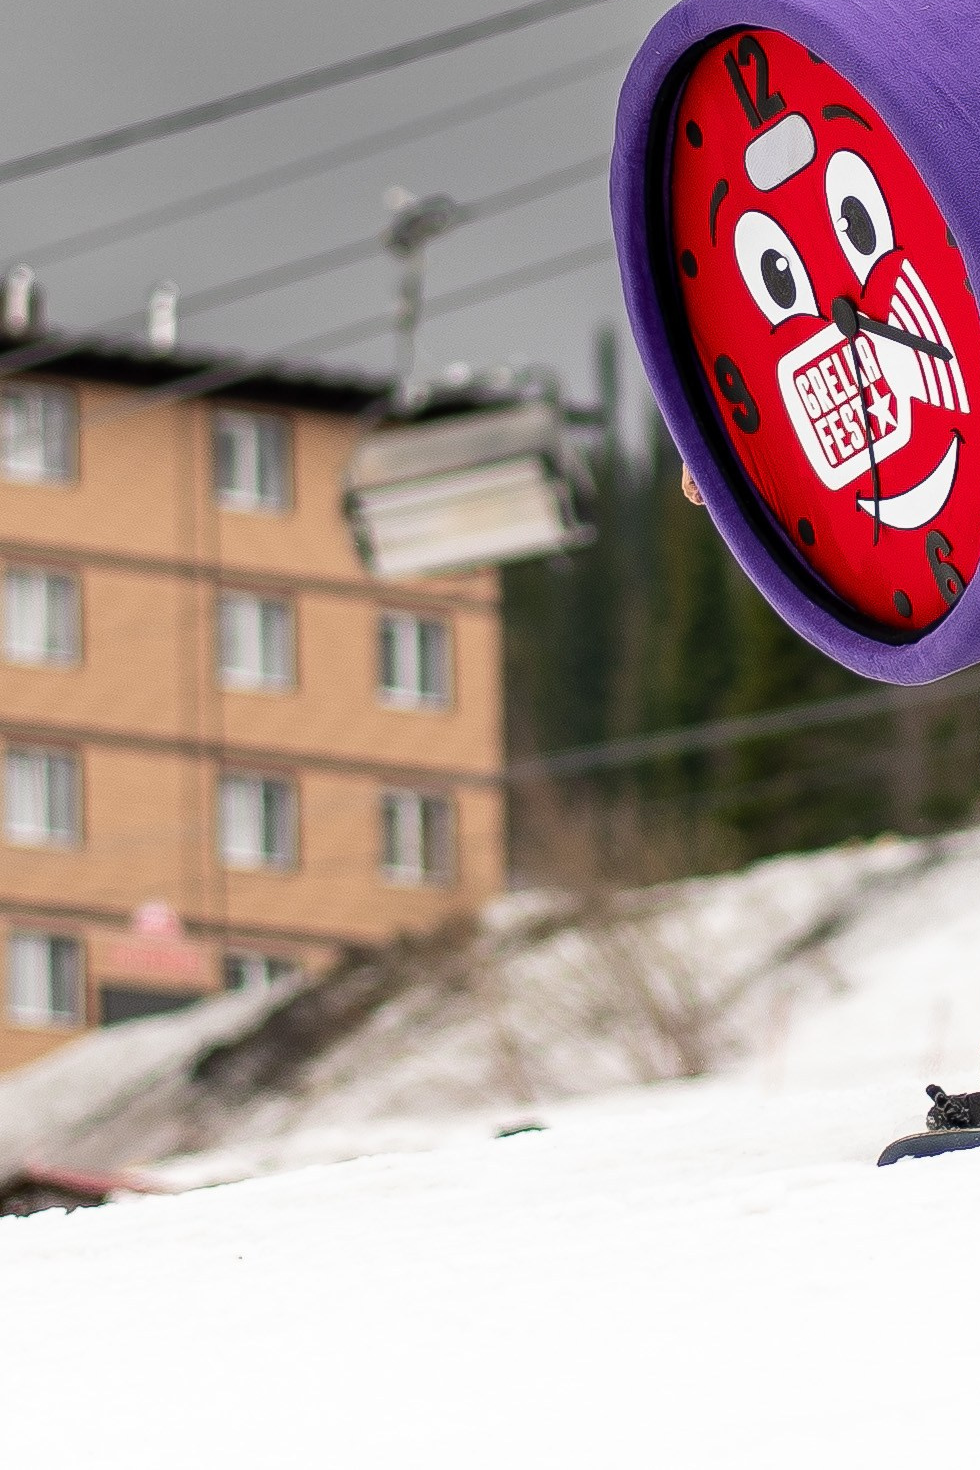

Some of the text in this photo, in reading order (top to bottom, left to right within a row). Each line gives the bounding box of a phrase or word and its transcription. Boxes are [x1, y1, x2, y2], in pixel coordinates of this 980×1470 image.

[724, 37, 786, 130] 12
[715, 356, 760, 434] 9
[926, 531, 965, 607] 6
